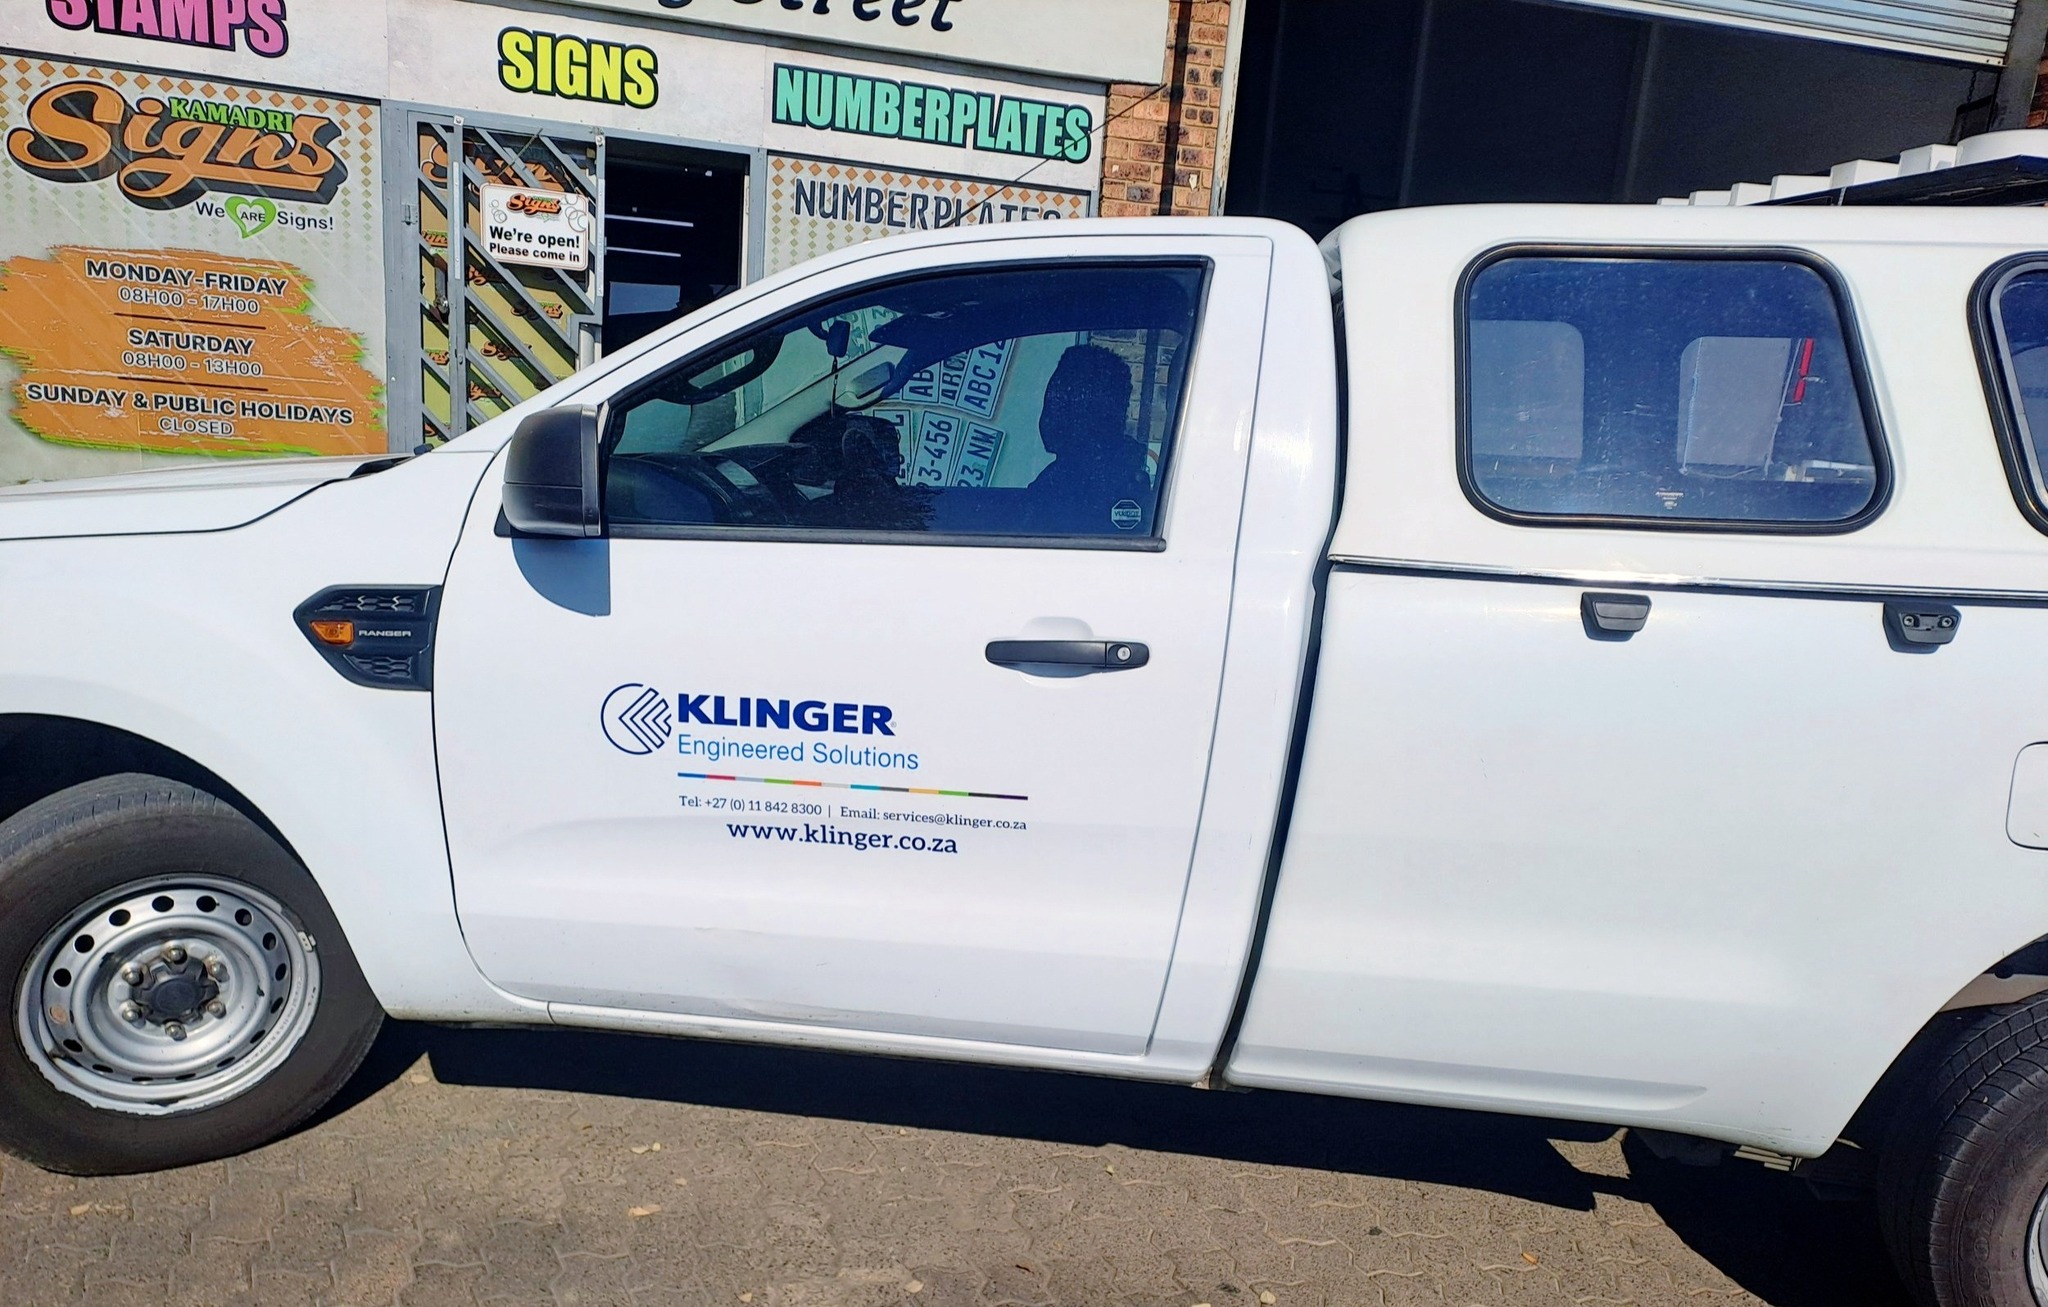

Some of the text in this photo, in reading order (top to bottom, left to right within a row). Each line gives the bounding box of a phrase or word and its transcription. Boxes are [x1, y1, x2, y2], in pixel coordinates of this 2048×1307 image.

[500, 28, 657, 107] SIGNS
[169, 97, 295, 133] KAMADRI
[775, 64, 1091, 162] NUMBERPLATES
[8, 80, 340, 204] Signs
[196, 201, 334, 231] We ARE Signs!
[489, 225, 581, 250] We're open!
[489, 242, 581, 263] Please come in
[86, 260, 288, 297] MONDAY-FRIDAY
[119, 287, 183, 307] 08H00
[202, 295, 260, 314] 17H00
[128, 329, 254, 356] SATURDAY
[123, 351, 186, 371] 08H00
[204, 358, 262, 377] 13H00
[27, 384, 354, 425] SUNDAY & PUBLIC HOLIDAYS
[964, 365, 997, 410] ABC
[159, 417, 234, 436] CLOSED
[359, 629, 412, 637] RANGER
[678, 734, 919, 770] Engineered Solutions
[679, 795, 702, 808] Tel:
[705, 797, 727, 809] +27
[730, 797, 745, 813] (0)
[749, 800, 762, 812] 11
[764, 801, 788, 814] 842
[791, 803, 822, 816] 8300
[840, 806, 880, 820] Email:
[883, 810, 1027, 831] services@klinger.co.za
[727, 823, 958, 855] www.klinger.co.za
